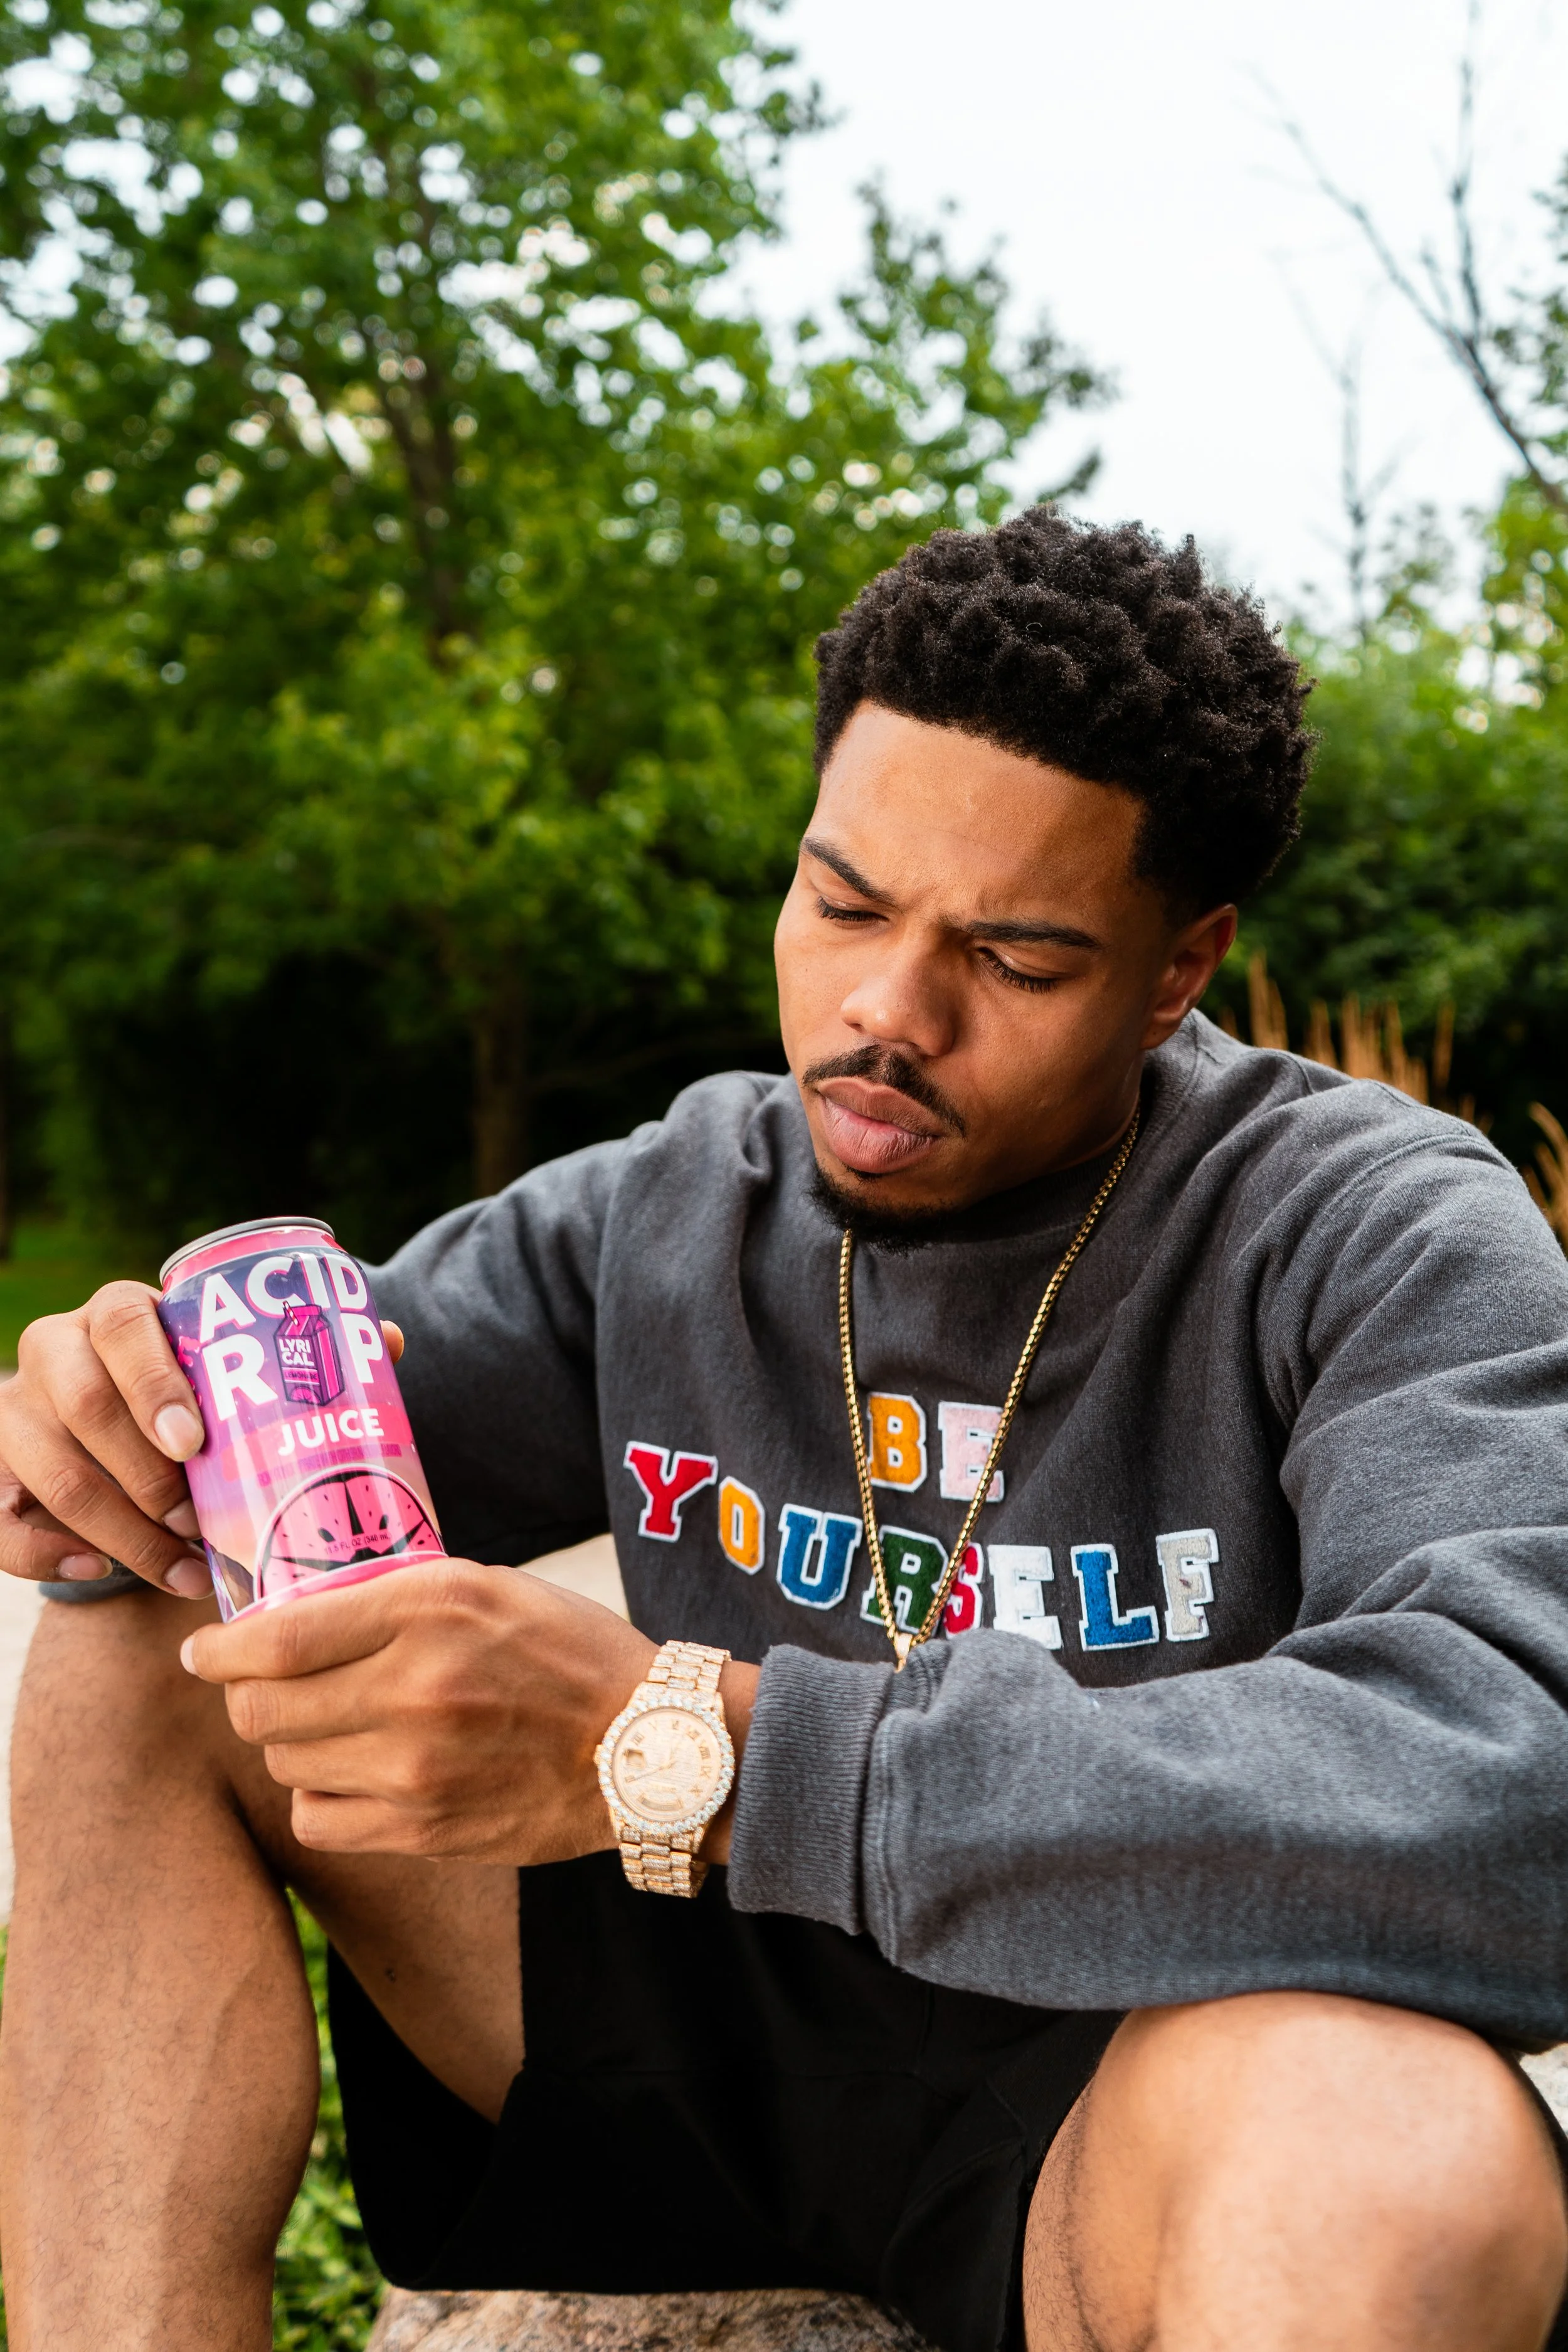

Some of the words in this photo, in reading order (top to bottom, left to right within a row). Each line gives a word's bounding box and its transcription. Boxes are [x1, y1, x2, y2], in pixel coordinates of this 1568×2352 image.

[199, 1253, 368, 1343] ACID
[278, 1338, 311, 1353] LYRI
[282, 1352, 314, 1366] CAL
[277, 1409, 384, 1456] JUICE
[867, 1391, 1004, 1503] BE
[352, 1537, 361, 1547] OZ
[364, 1534, 378, 1545] (340
[623, 1441, 1220, 1651] YOURSELF
